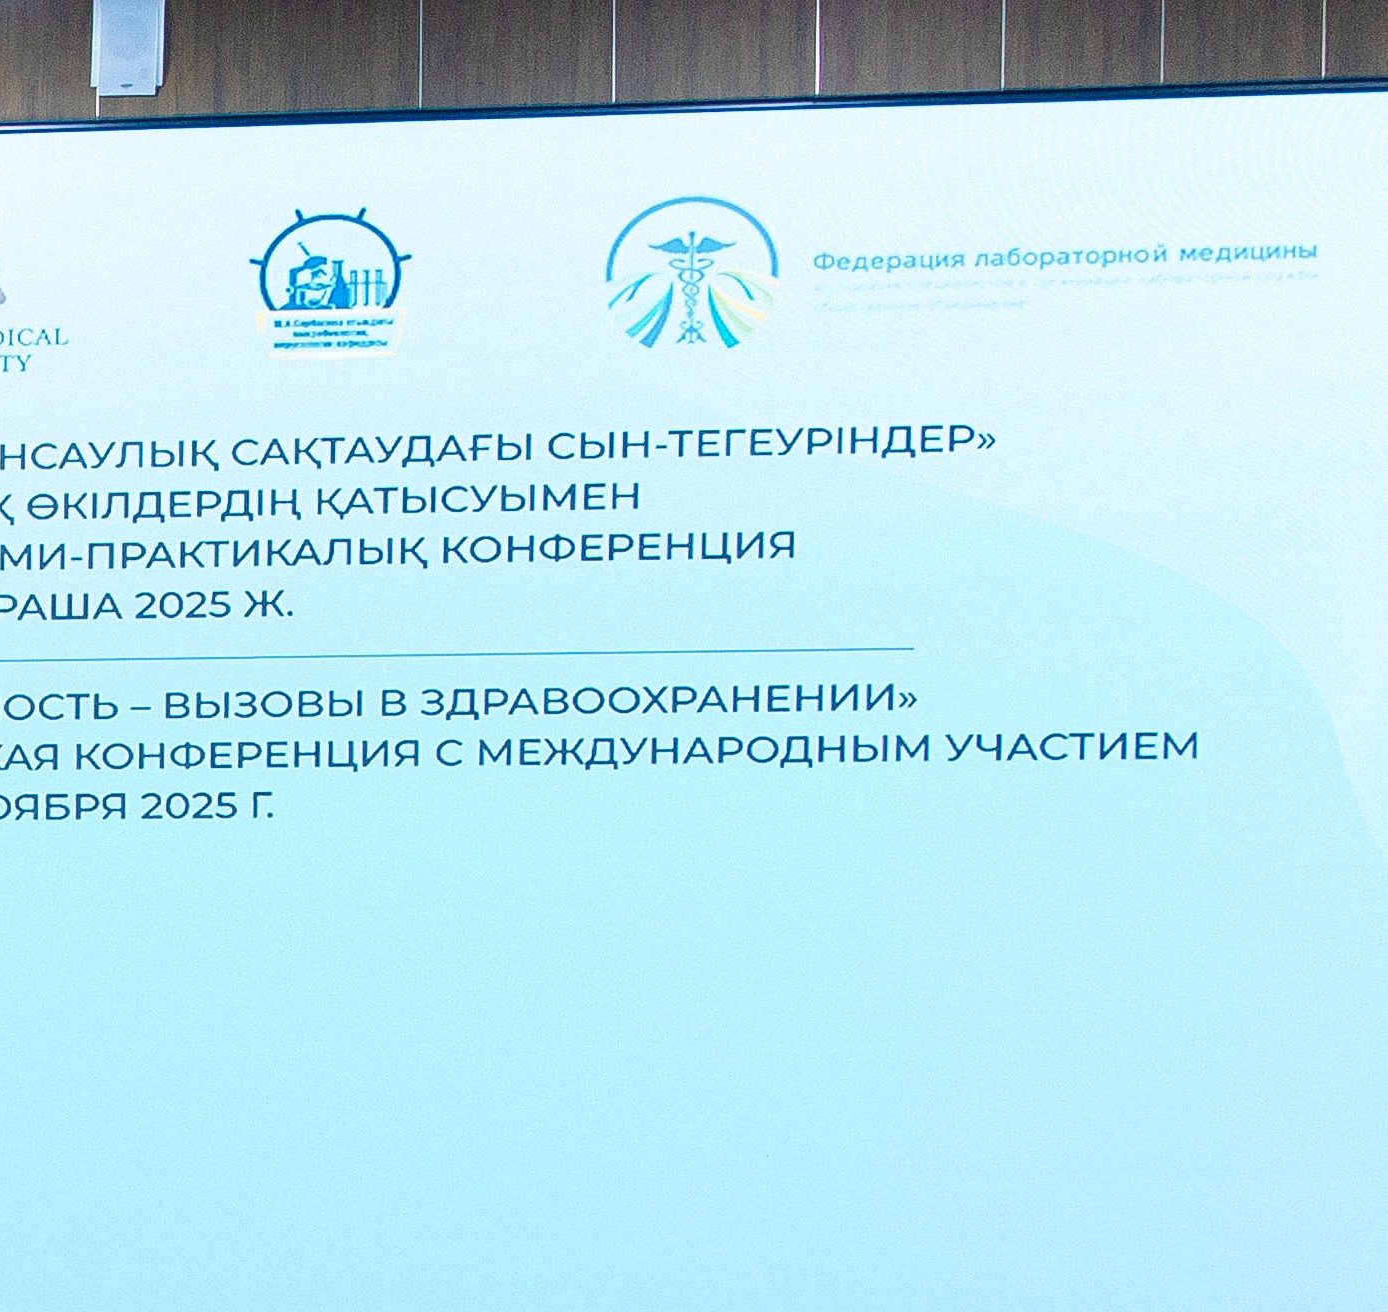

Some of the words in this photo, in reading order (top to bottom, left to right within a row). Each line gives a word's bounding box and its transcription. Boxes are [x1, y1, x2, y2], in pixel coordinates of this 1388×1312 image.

[814, 252, 965, 273] Федерация
[975, 244, 1167, 271] лабораторной
[1180, 245, 1317, 263] медицины
[232, 433, 531, 469] САҚТАУДАҒЫ
[549, 424, 995, 460] СЫН-ТЕГЕУРІНДЕР»
[28, 488, 301, 524] ӨКІЛДЕРДІҢ
[318, 482, 639, 520] ҚАТЫСУЫМЕН
[443, 531, 794, 565] КОНФЕРЕНЦИЯ
[136, 590, 231, 619] 2025
[245, 590, 293, 618] Ж.
[166, 690, 362, 719] ВЫЗОВЫ
[382, 689, 407, 716] В
[421, 683, 917, 721] ЗДРАВООХРАНЕНИИ»
[77, 740, 419, 772] КОНФЕРЕНЦИЯ
[437, 738, 462, 766] С
[479, 734, 929, 770] МЕЖДУНАРОДНЫМ
[946, 732, 1197, 762] УЧАСТИЕМ
[142, 792, 237, 820] 2025
[253, 791, 273, 819] Г.
